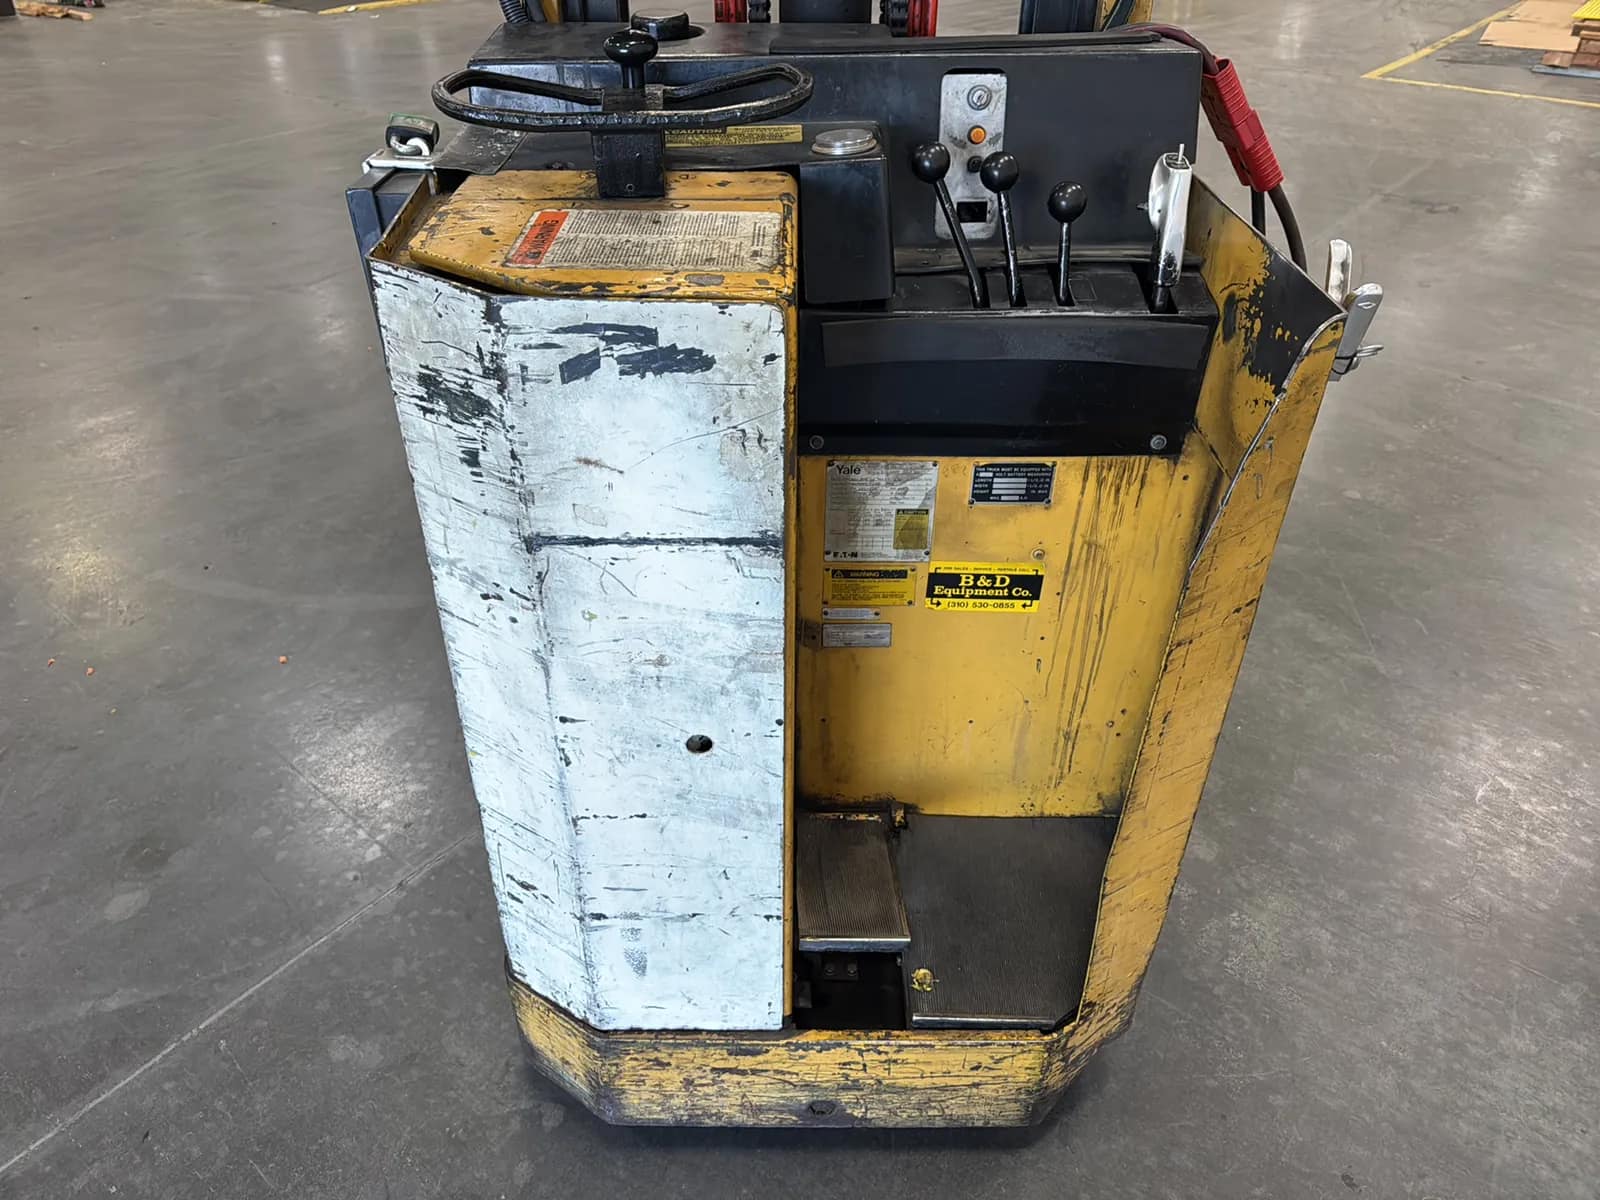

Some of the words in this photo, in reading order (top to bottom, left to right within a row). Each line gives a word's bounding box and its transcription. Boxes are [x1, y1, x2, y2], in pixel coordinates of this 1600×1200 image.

[532, 219, 560, 249] WARNING
[836, 465, 861, 475] Yale
[933, 585, 1009, 598] Equipment
[1012, 587, 1033, 597] Co.
[947, 601, 969, 609] (310)
